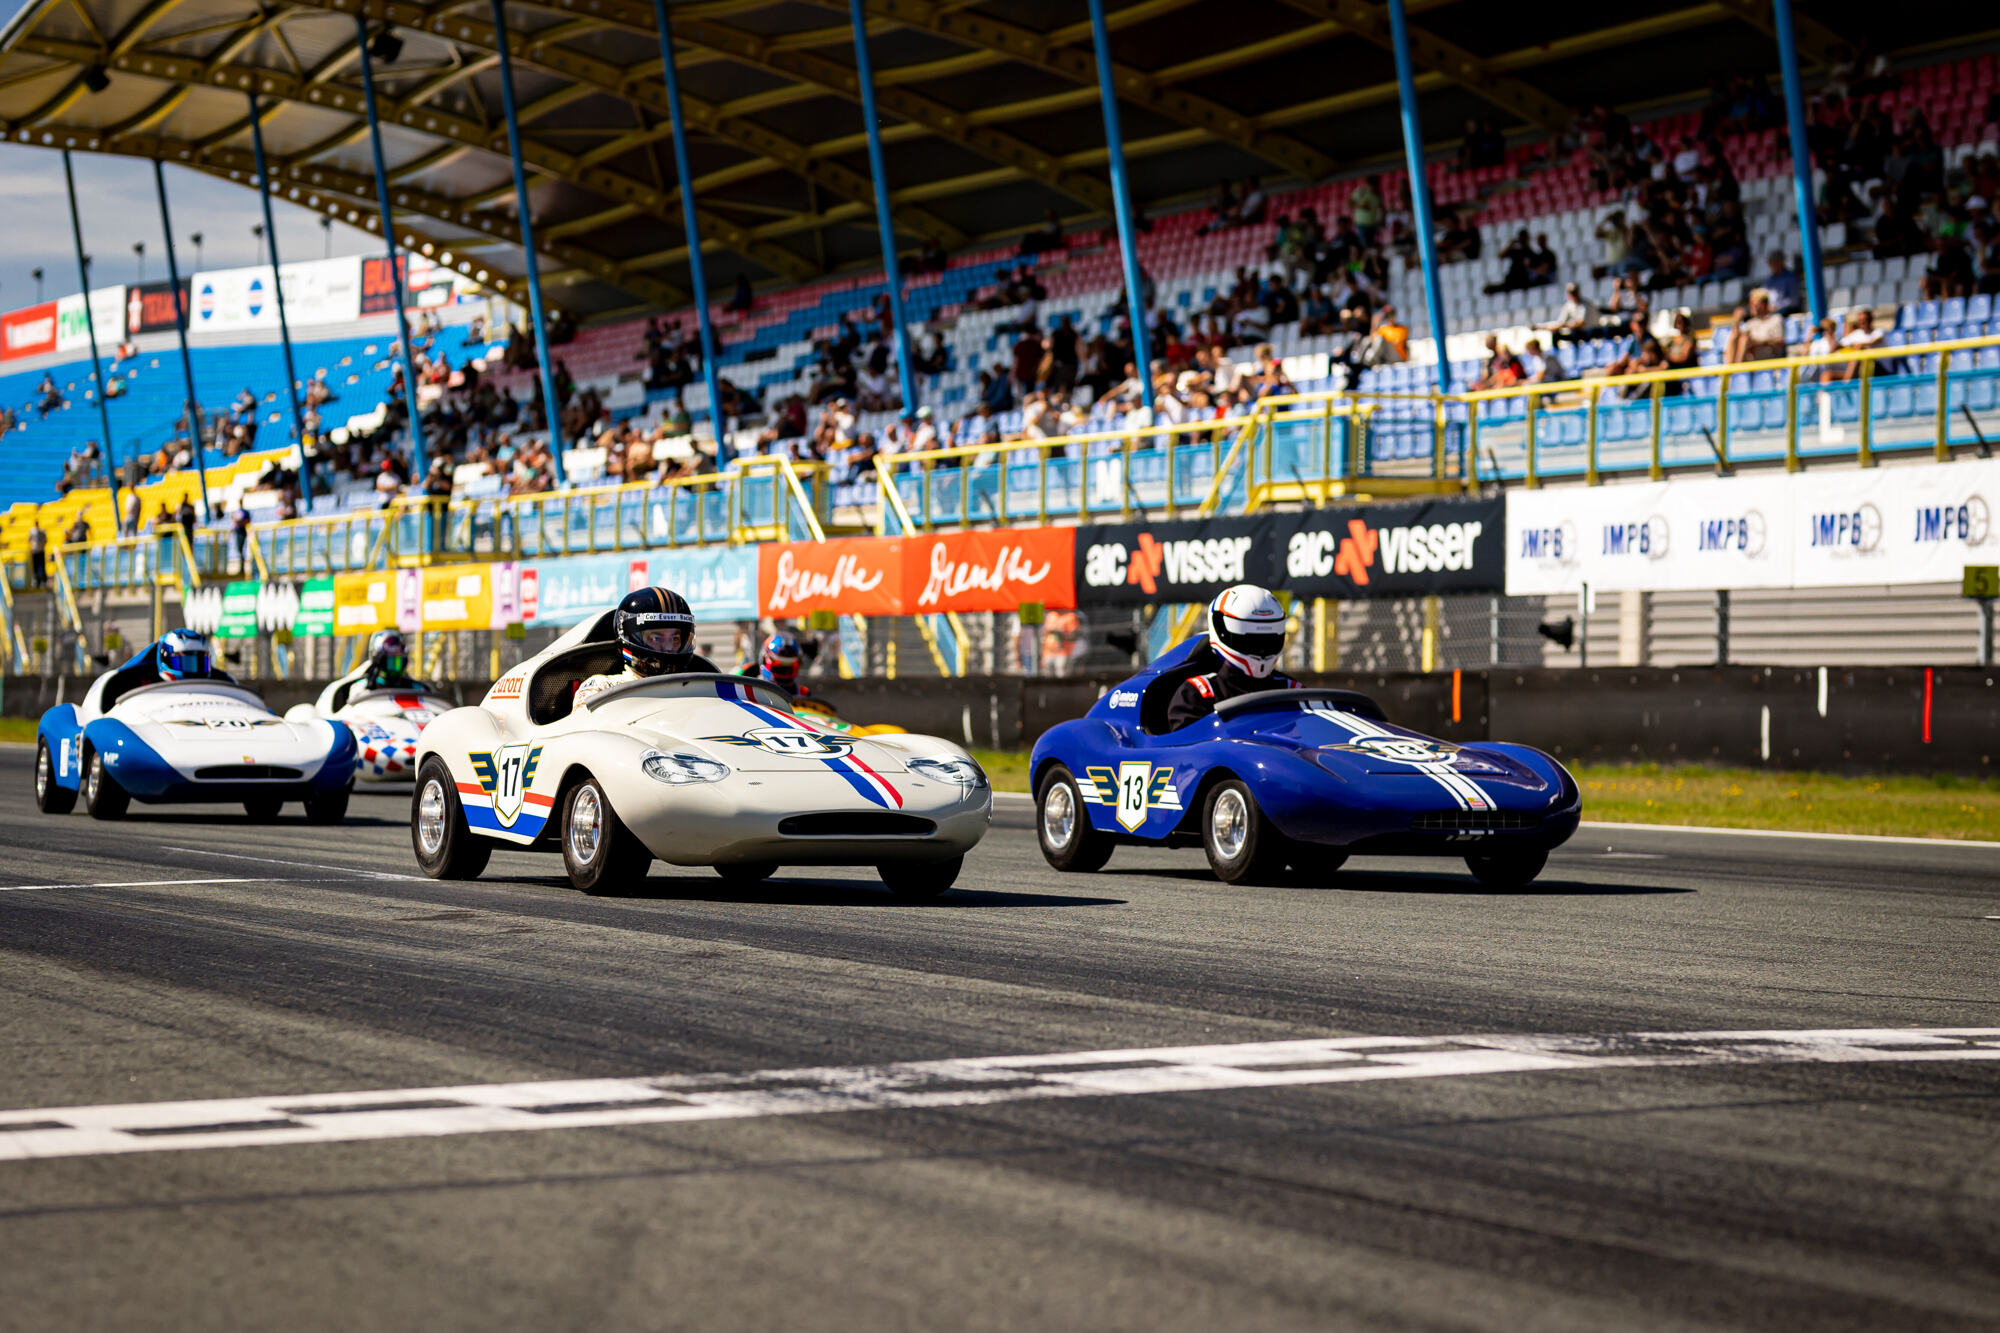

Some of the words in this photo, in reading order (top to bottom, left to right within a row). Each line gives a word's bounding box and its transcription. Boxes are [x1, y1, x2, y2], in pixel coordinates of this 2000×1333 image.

[1163, 535, 1252, 584] visser
[1378, 520, 1482, 574] visser
[1975, 569, 1989, 595] 5
[210, 719, 246, 728] 20
[765, 736, 809, 748] 17
[1382, 745, 1425, 754] 13
[502, 757, 521, 797] 17
[1124, 775, 1143, 810] 13
